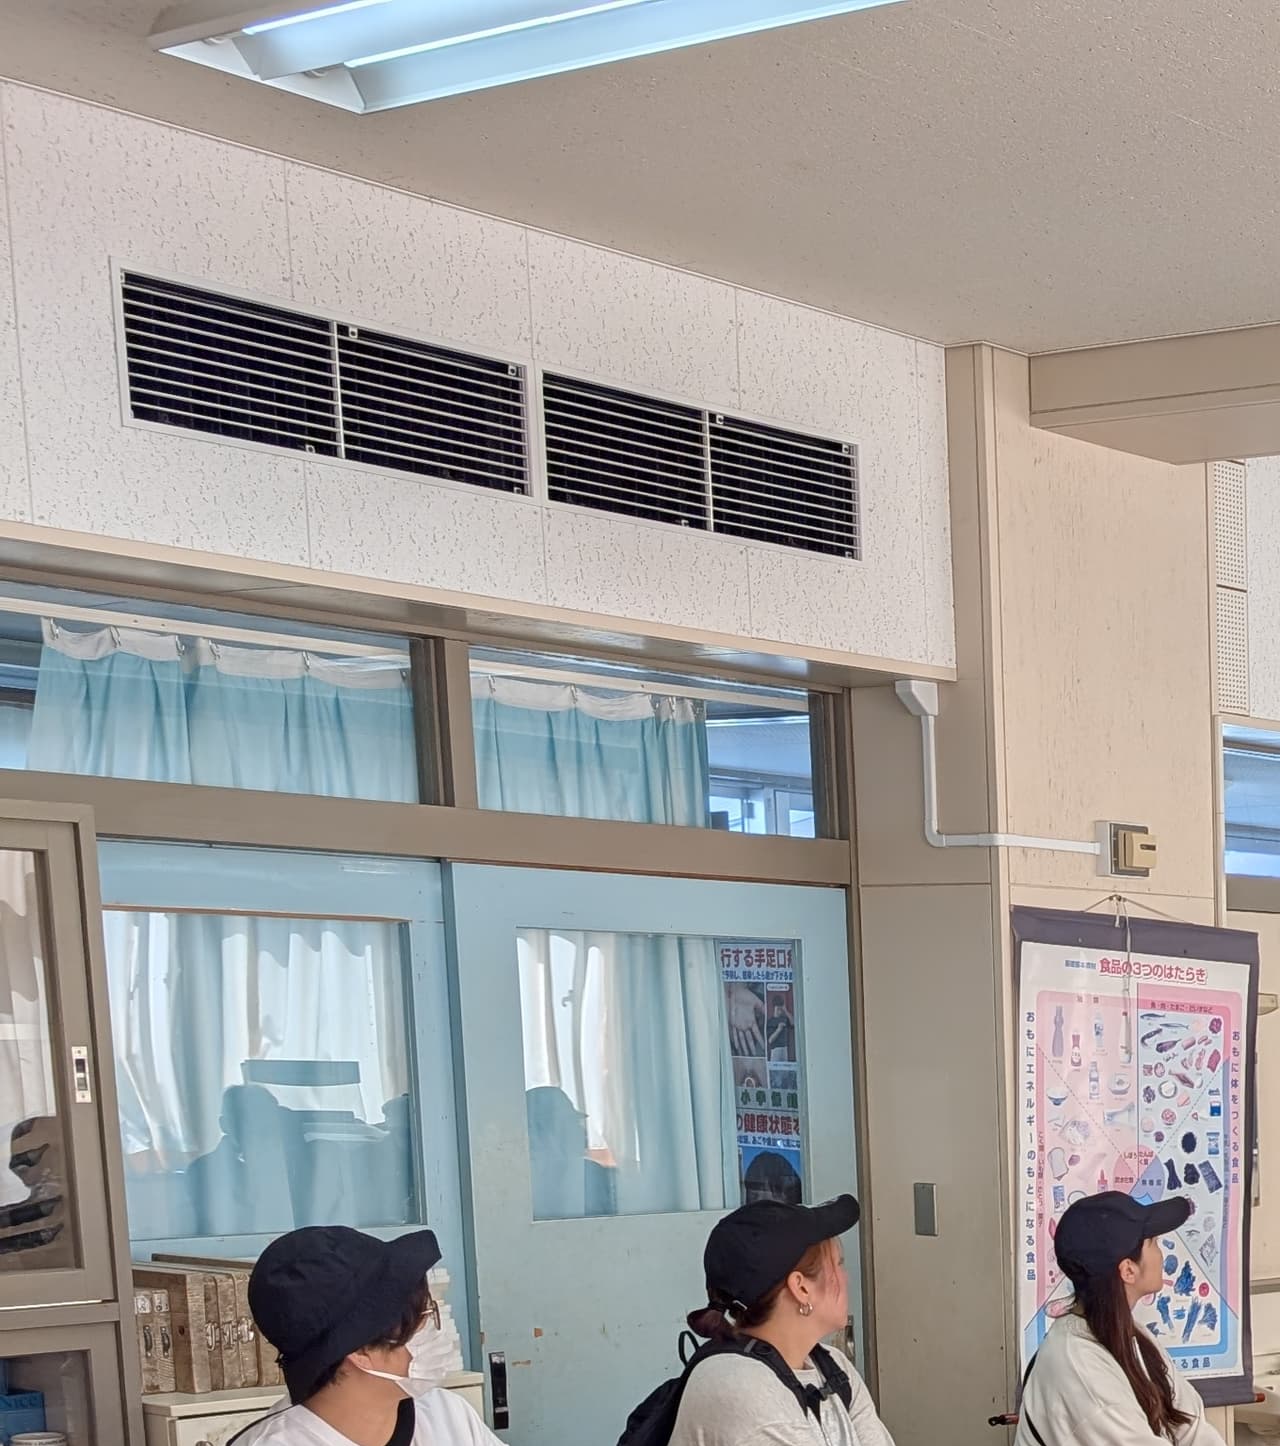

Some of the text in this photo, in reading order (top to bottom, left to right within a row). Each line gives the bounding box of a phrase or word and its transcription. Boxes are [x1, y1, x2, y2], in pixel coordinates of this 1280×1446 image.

[1099, 957, 1206, 983] 食品の3つのはたらき
[1025, 1012, 1037, 1281] おもにエネルギーのもとになる食品
[1230, 1031, 1240, 1184] おもに体をつくる食品
